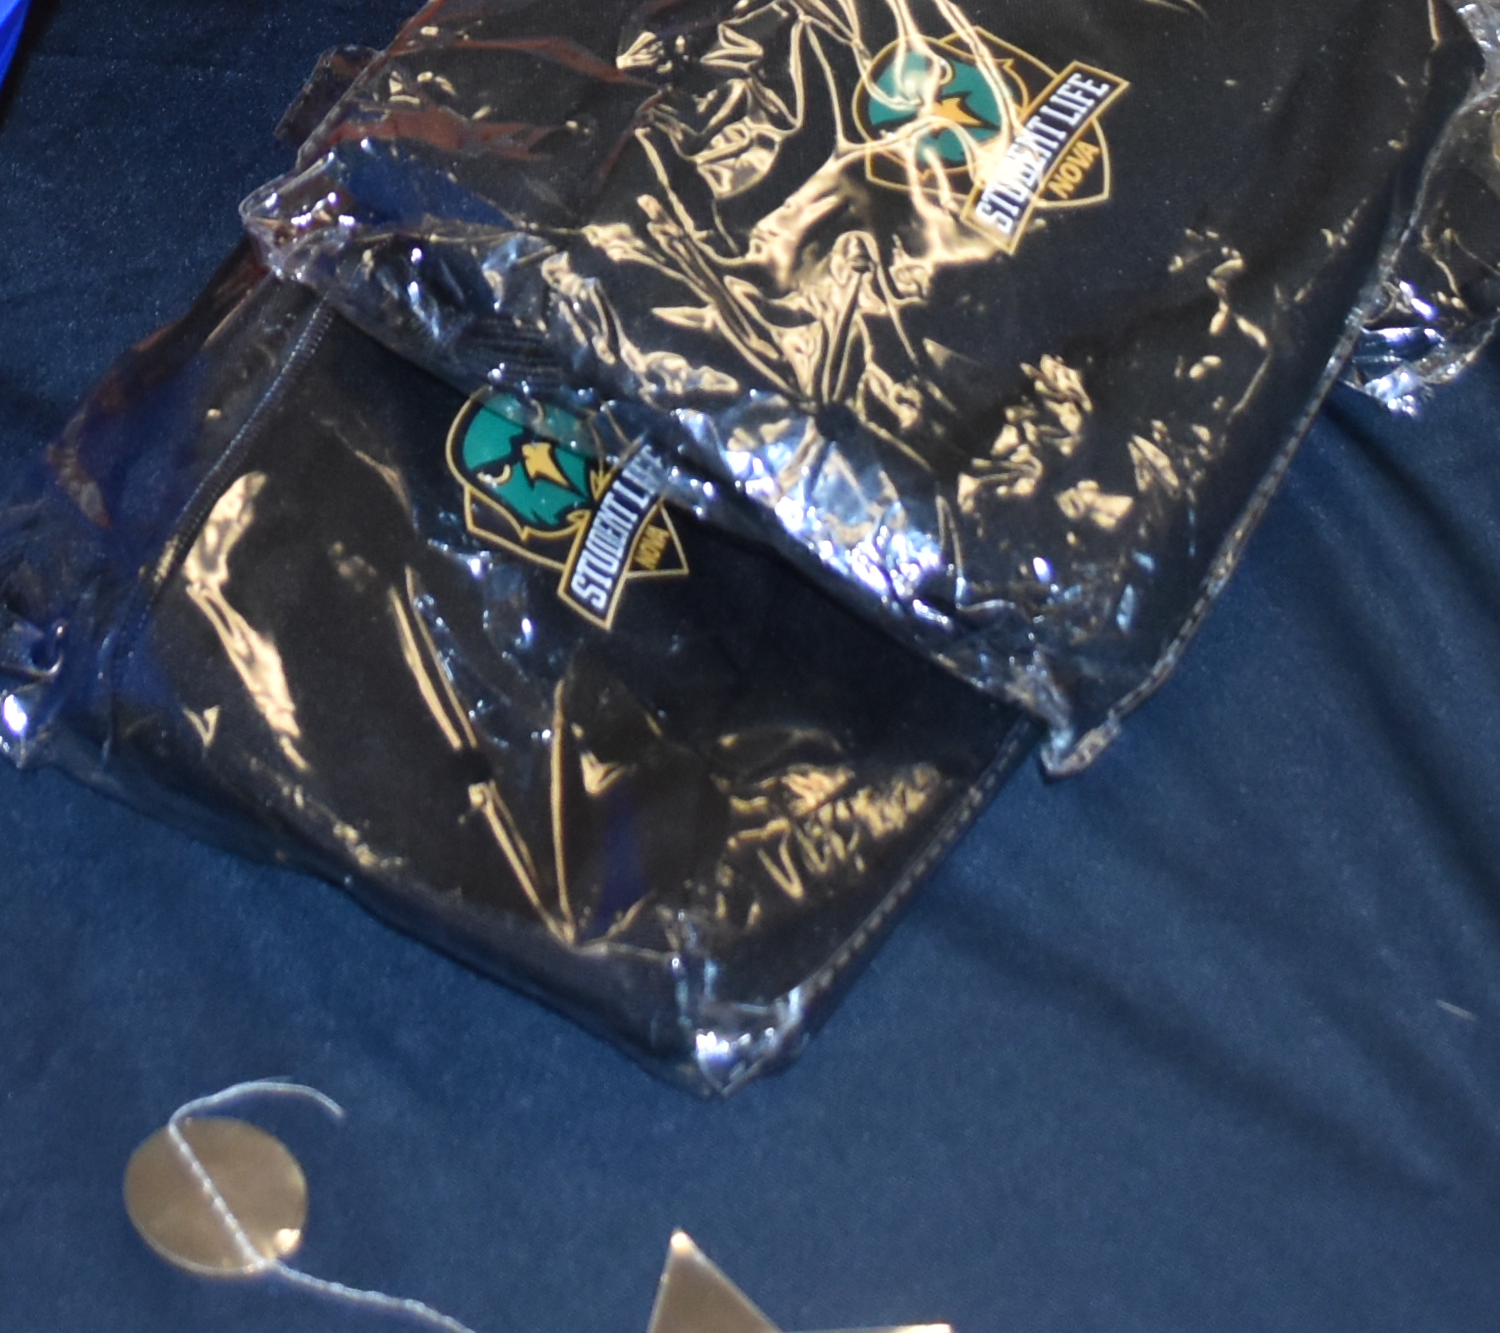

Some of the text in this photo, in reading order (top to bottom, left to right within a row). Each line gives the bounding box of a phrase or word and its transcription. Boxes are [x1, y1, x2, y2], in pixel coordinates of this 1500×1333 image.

[975, 72, 1111, 235] STUDENT LIFE
[1048, 140, 1101, 200] NOVA
[570, 490, 639, 611] STUDENT
